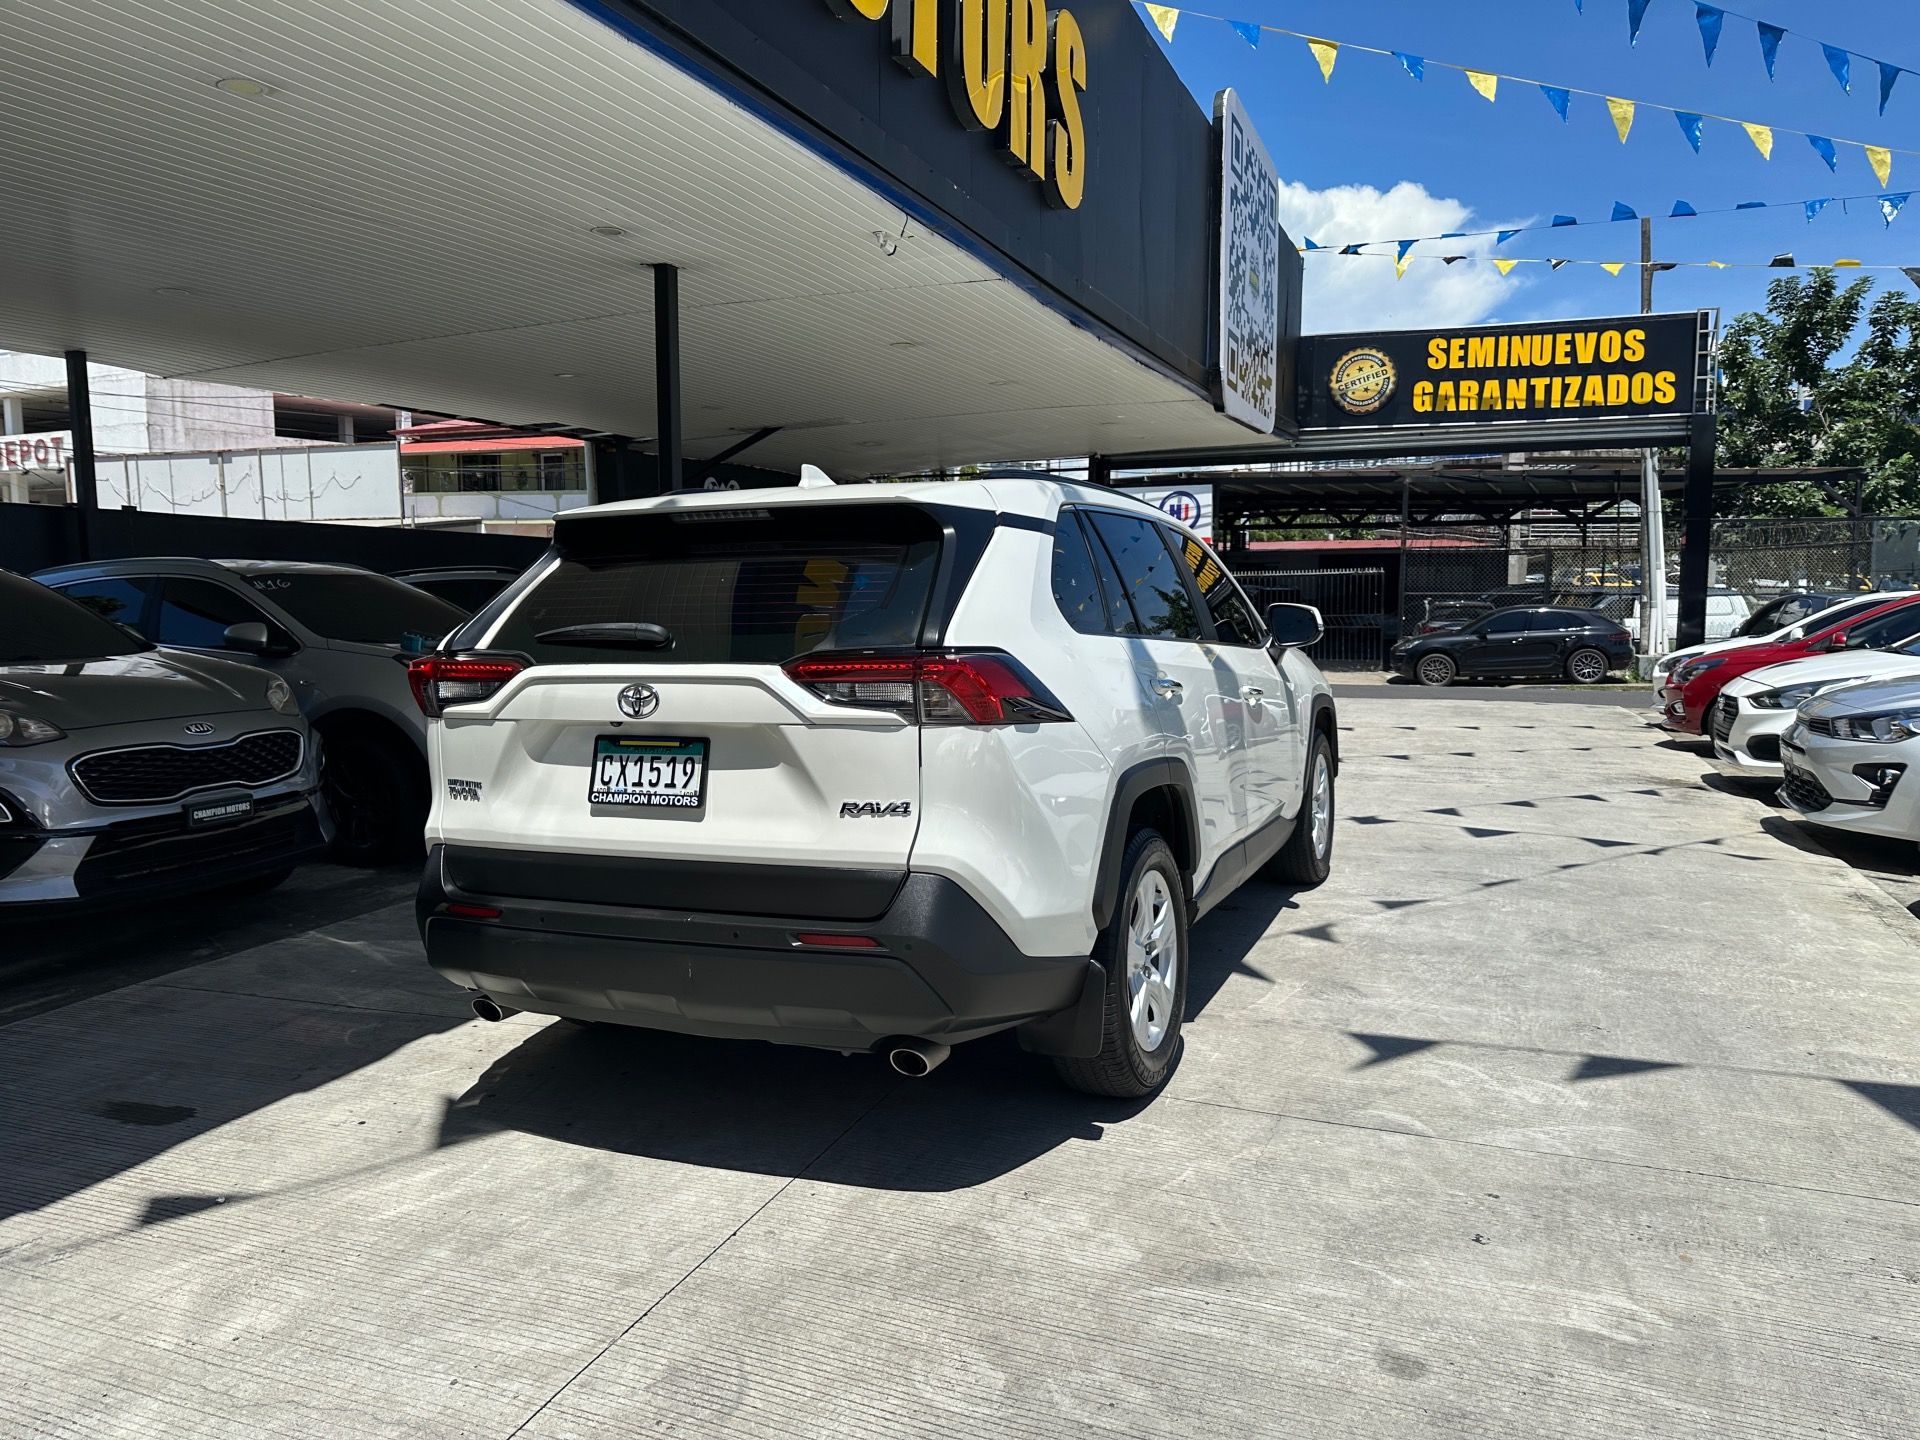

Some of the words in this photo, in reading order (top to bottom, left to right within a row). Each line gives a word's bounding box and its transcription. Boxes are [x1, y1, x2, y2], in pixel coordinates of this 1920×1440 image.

[1427, 329, 1646, 369] SEMINUEVOS
[1338, 369, 1388, 392] CERTIFIED
[1413, 371, 1676, 412] GARANTIZADOS
[0, 437, 63, 467] EPOT
[187, 722, 213, 733] KIA
[600, 754, 696, 789] CX1519
[193, 806, 225, 819] CHAMPION
[226, 802, 250, 813] MOTORS
[591, 793, 648, 805] CHAMPION
[650, 795, 698, 806] MOTORS
[840, 802, 912, 815] RAV4
